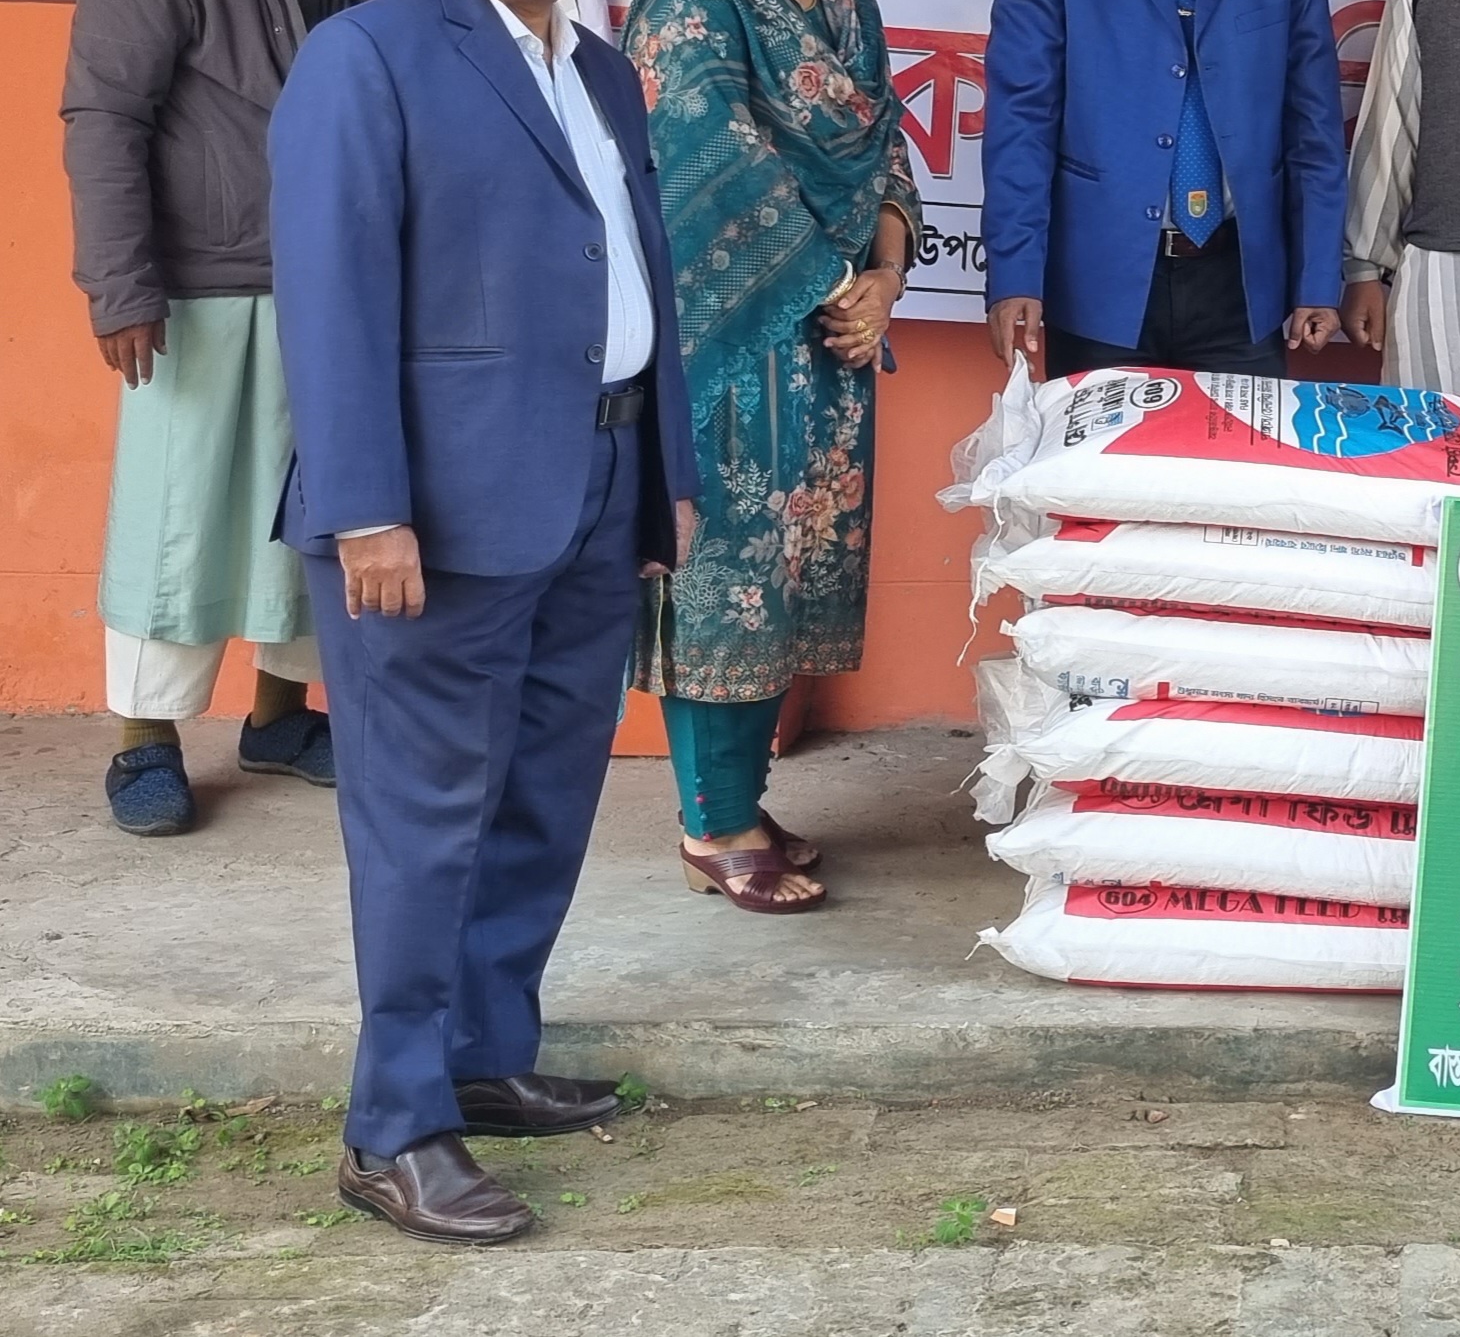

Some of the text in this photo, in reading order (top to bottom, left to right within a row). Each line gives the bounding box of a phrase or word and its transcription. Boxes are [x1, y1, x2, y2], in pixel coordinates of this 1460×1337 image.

[1142, 380, 1165, 405] 604
[1104, 890, 1153, 907] 604
[1164, 890, 1265, 914] MEGA
